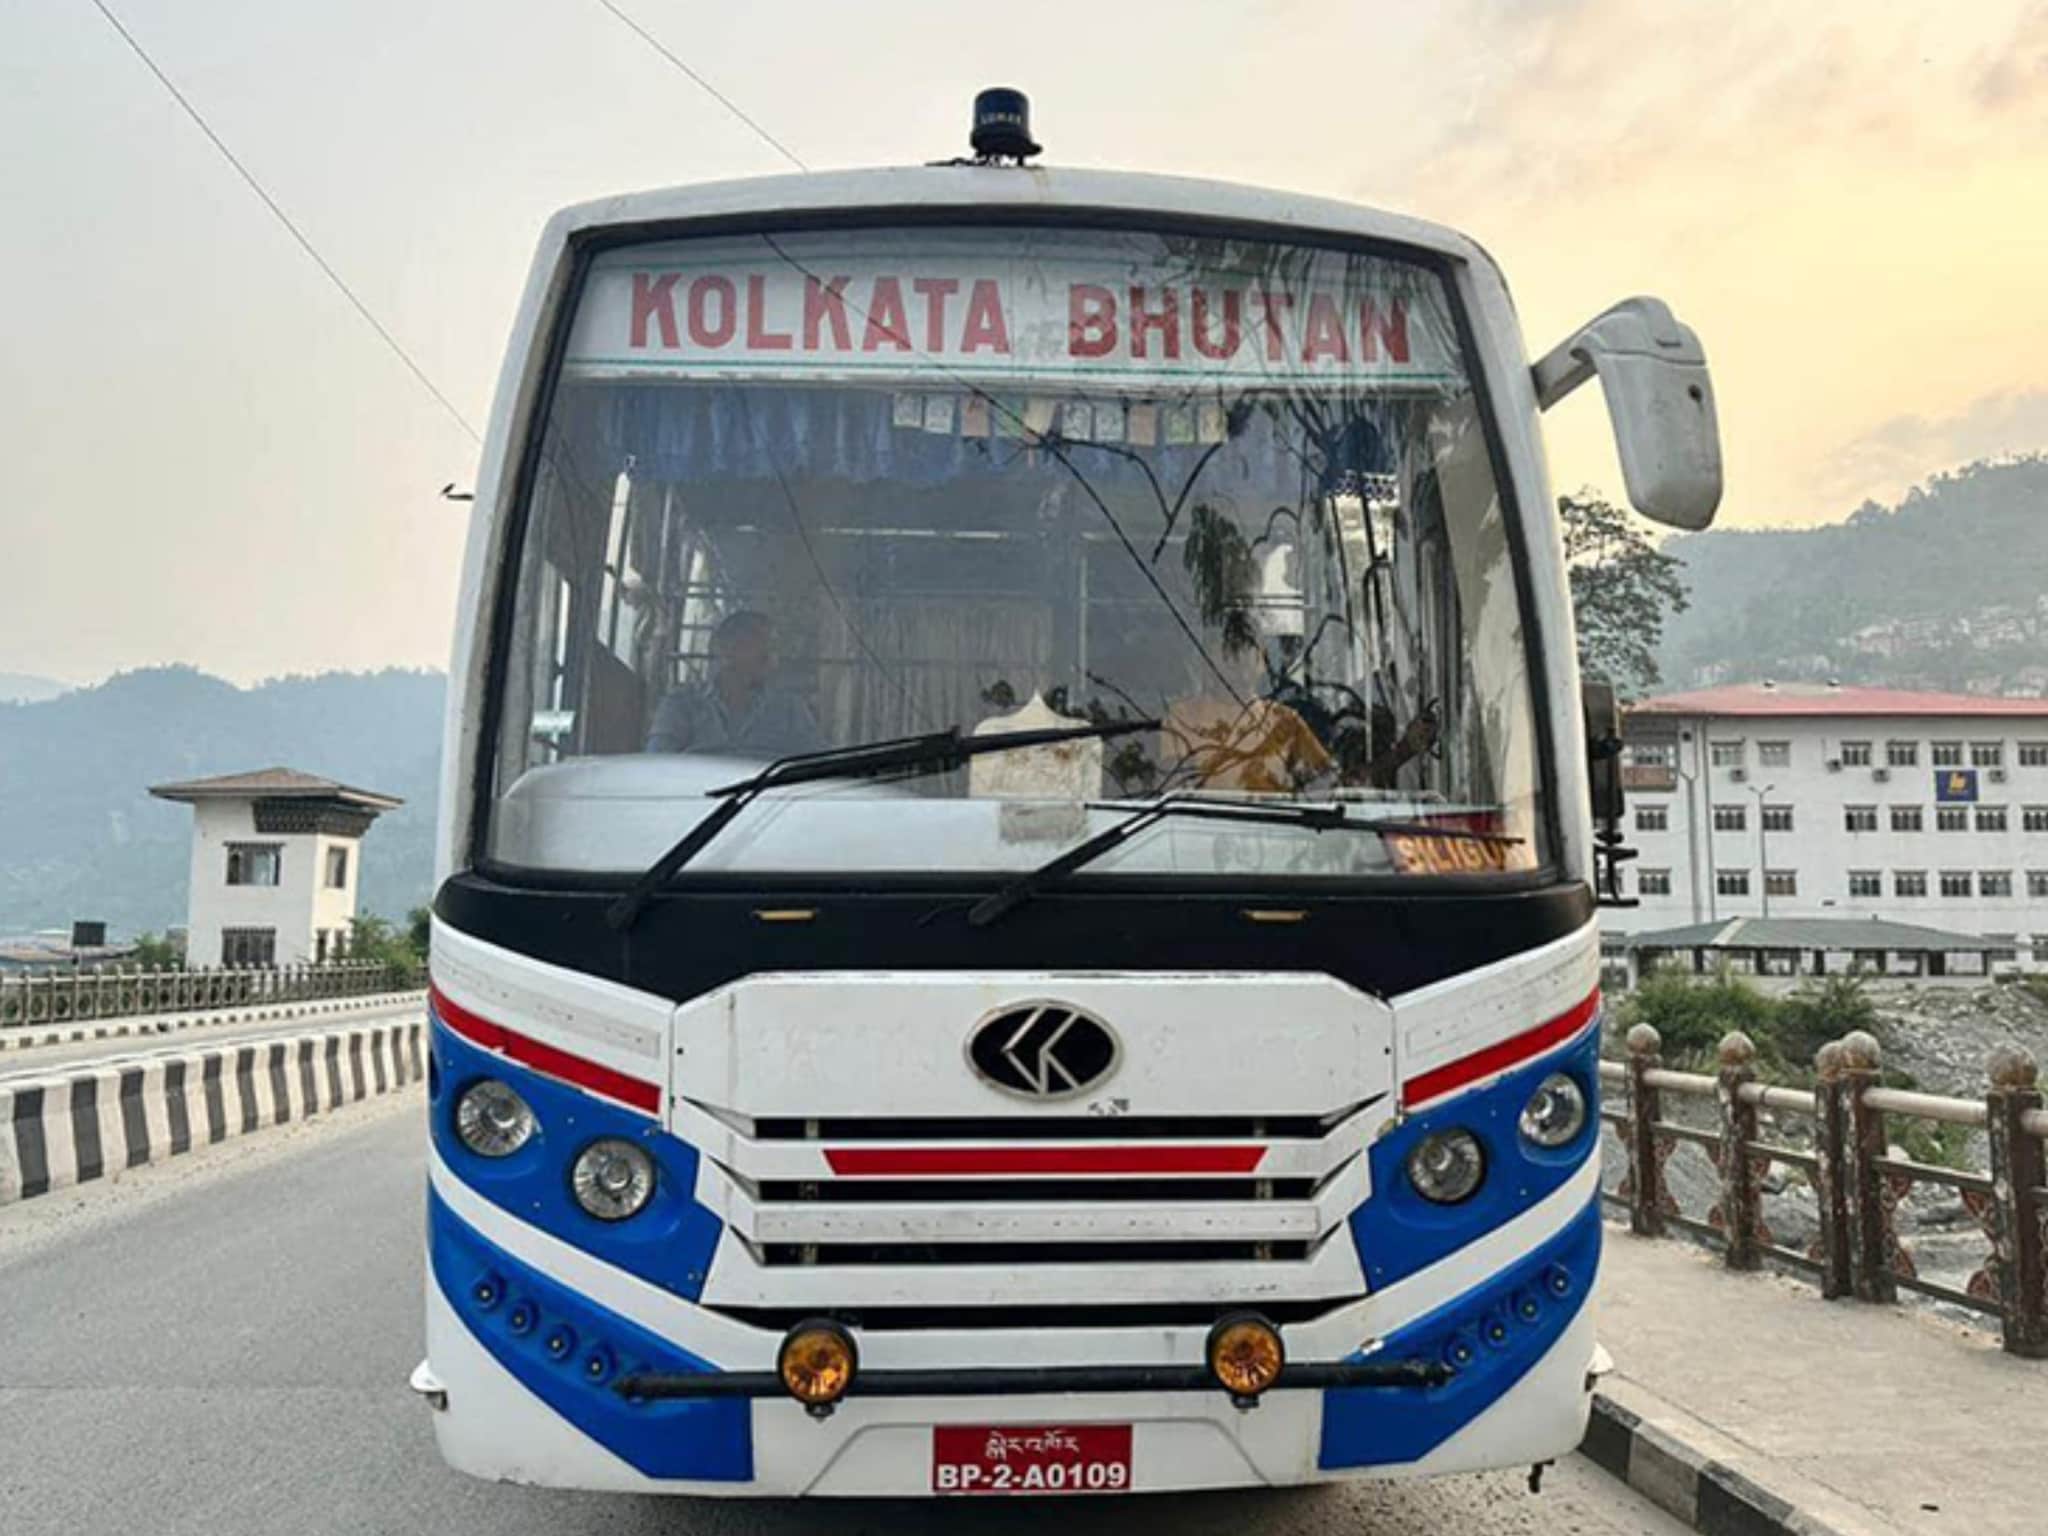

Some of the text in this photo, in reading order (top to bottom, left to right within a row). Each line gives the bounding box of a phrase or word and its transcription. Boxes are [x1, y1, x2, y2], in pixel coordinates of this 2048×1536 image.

[629, 272, 1412, 364] KOLKATA BHUTAN
[937, 1462, 1127, 1489] BP-2-A0109
